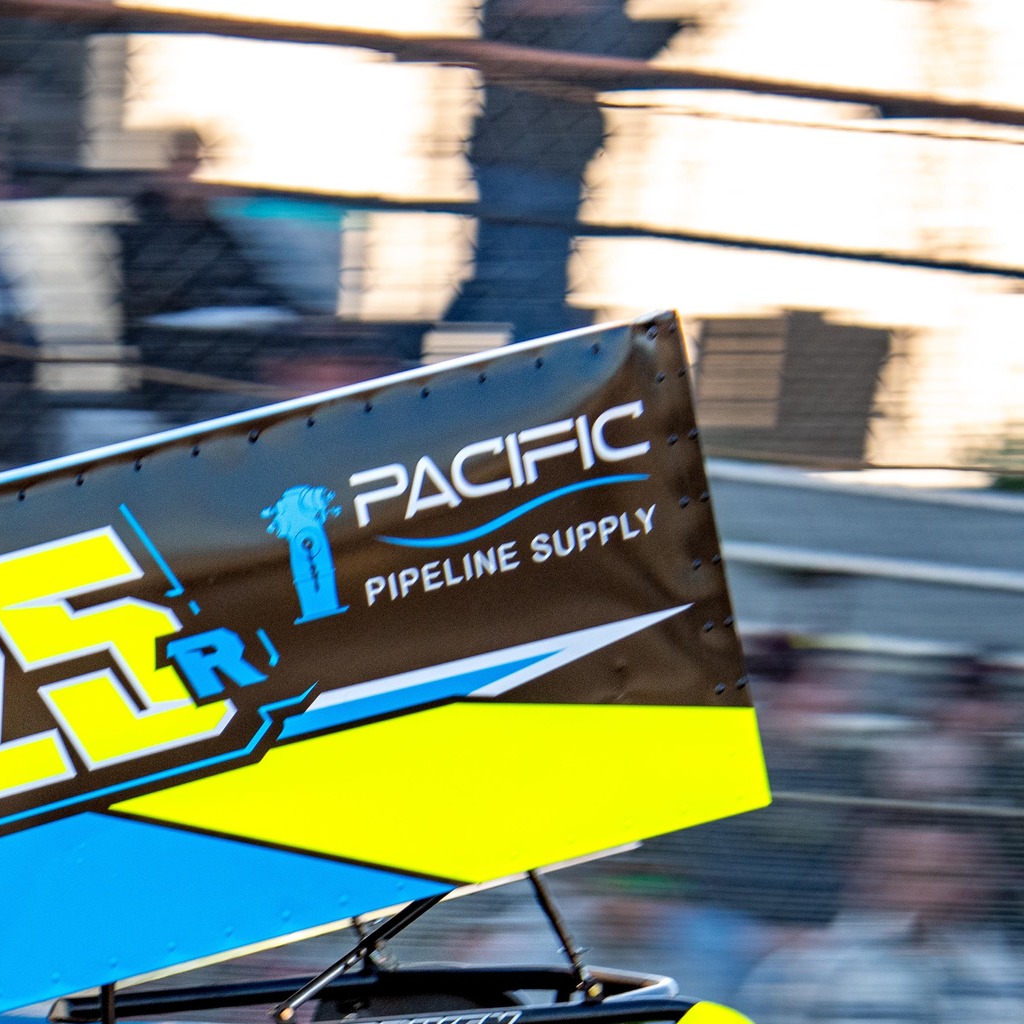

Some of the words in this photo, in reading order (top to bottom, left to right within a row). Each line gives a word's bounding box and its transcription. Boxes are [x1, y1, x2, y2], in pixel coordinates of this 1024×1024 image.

[349, 400, 651, 528] PACIFIC
[364, 540, 520, 607] PIPELINE
[530, 503, 656, 564] SUPPLY
